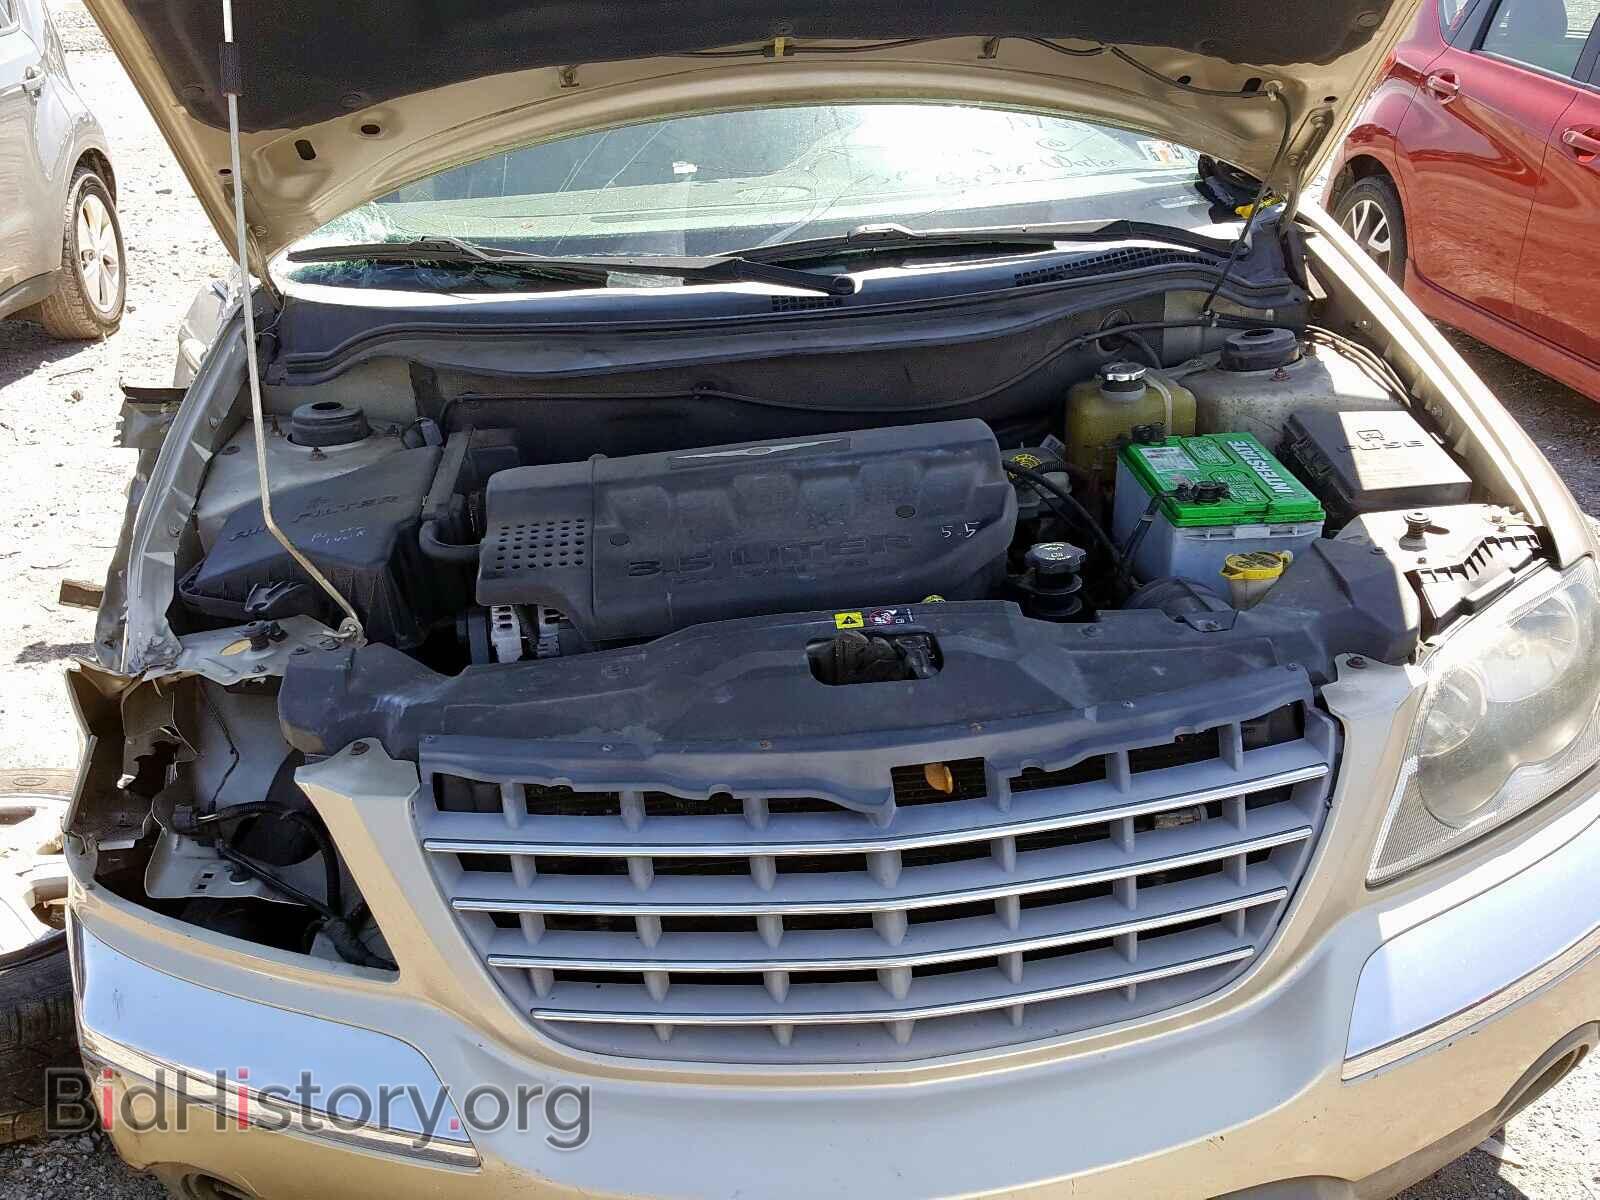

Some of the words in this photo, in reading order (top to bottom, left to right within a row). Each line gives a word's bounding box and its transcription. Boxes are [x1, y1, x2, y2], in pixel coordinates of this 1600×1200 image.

[1336, 440, 1424, 453] FUSE
[1227, 440, 1296, 494] INTERSTATE
[291, 495, 399, 525] FILTER
[628, 550, 715, 577] 3.5
[729, 534, 912, 568] LITER
